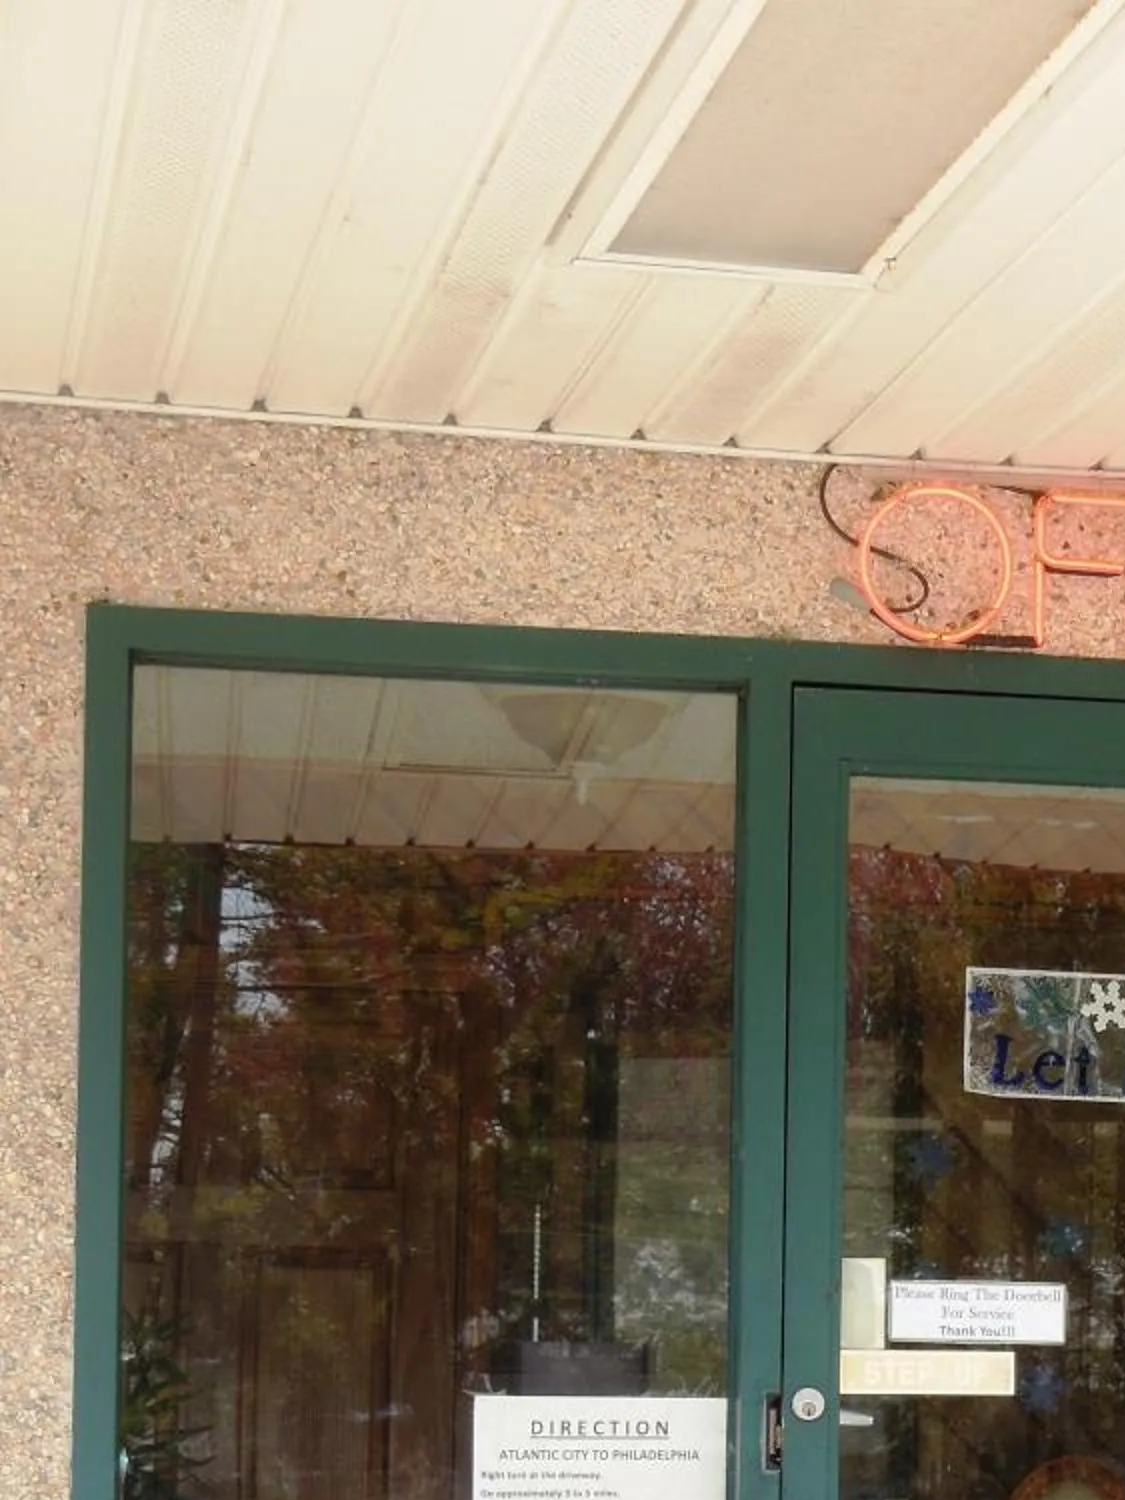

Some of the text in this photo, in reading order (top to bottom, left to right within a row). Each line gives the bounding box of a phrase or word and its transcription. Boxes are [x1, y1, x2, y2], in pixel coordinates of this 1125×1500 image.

[990, 1034, 1096, 1097] Let
[894, 1286, 1061, 1303] Please Ring The Doorbell
[941, 1305, 1014, 1320] For Service
[939, 1325, 976, 1337] Thank
[531, 1420, 669, 1436] DIRECTION
[500, 1449, 700, 1461] ATLANTIC CITY TO PHILADELPHIA
